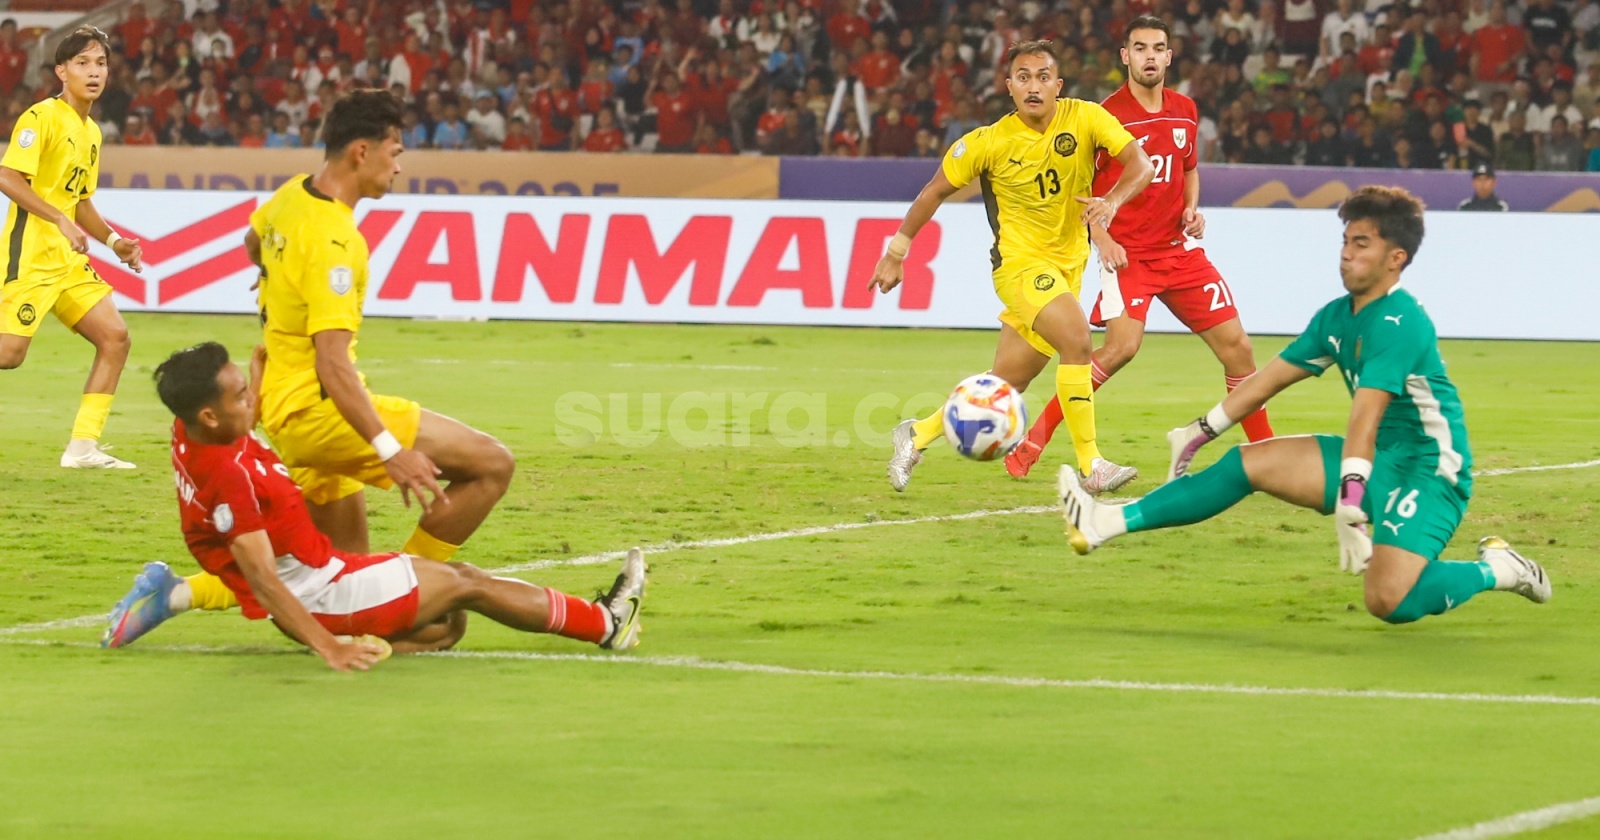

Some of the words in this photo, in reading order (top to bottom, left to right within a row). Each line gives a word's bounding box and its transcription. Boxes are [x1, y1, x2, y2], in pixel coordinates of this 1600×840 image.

[1034, 169, 1061, 199] 13
[1150, 154, 1173, 183] 21
[1203, 280, 1232, 312] 21
[1384, 487, 1420, 519] 16
